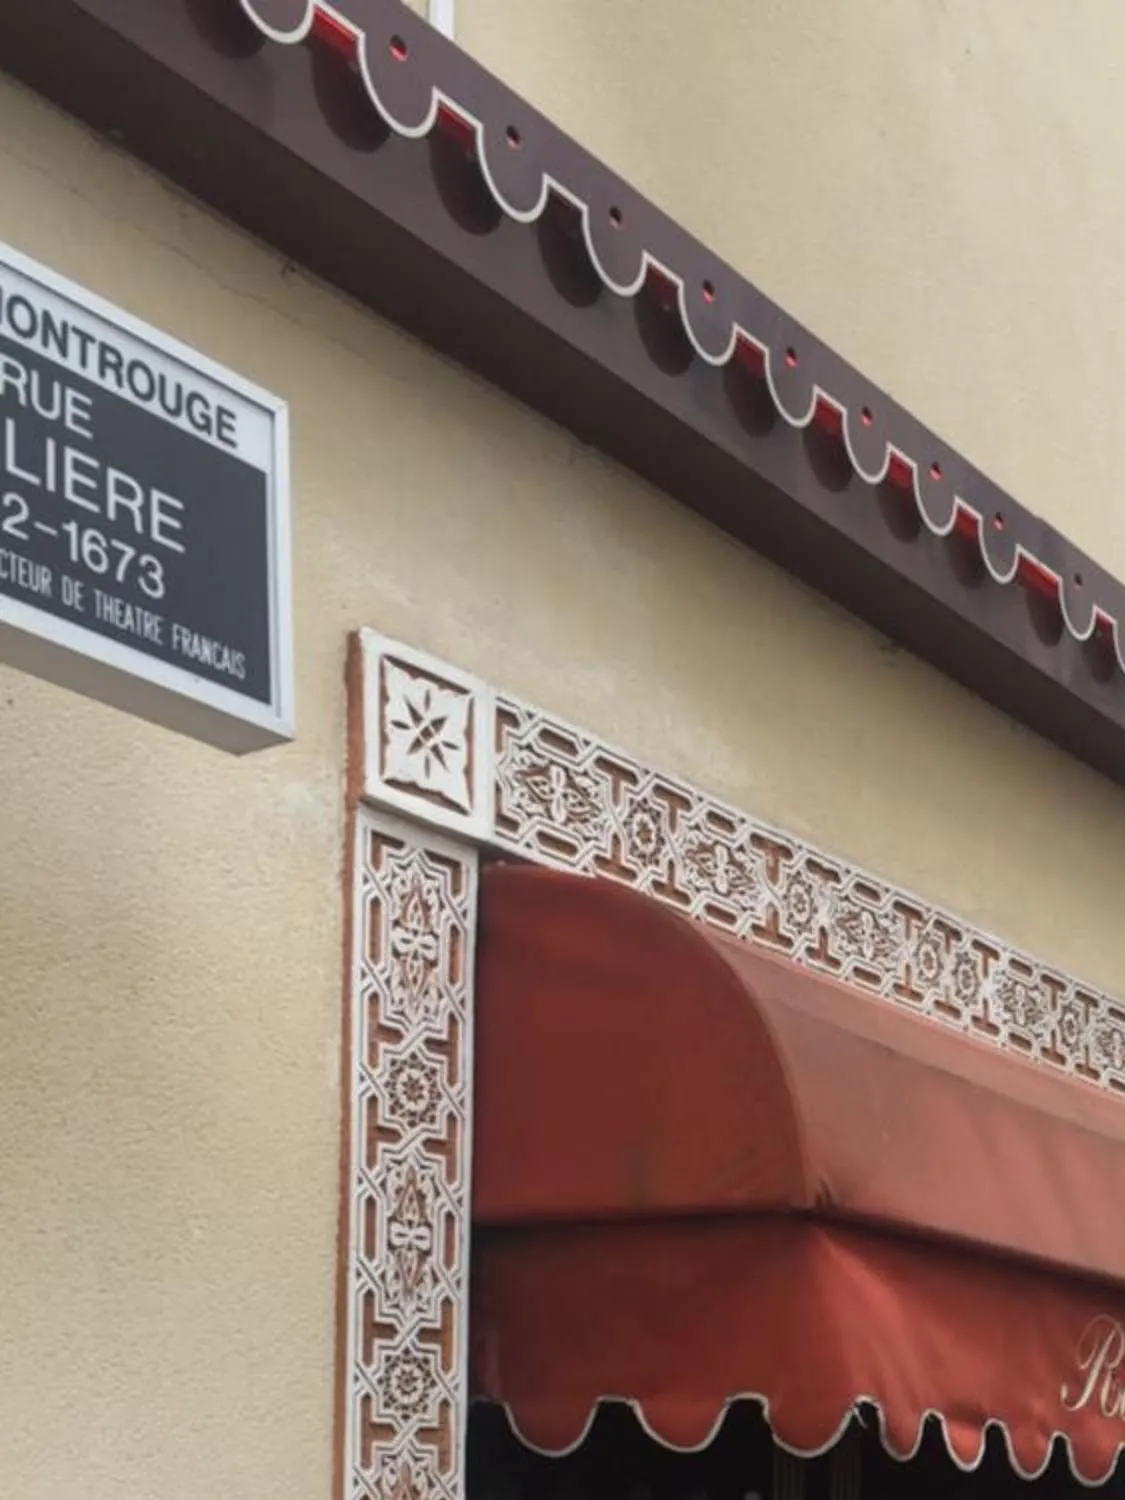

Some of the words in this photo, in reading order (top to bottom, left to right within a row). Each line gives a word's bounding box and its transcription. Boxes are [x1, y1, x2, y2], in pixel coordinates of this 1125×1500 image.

[0, 284, 238, 449] ONTROUGE
[0, 353, 93, 439] RUE
[5, 417, 186, 553] LIERE
[1, 492, 165, 599] 2-1673
[61, 574, 84, 612] DE
[94, 588, 164, 646] THEATRE
